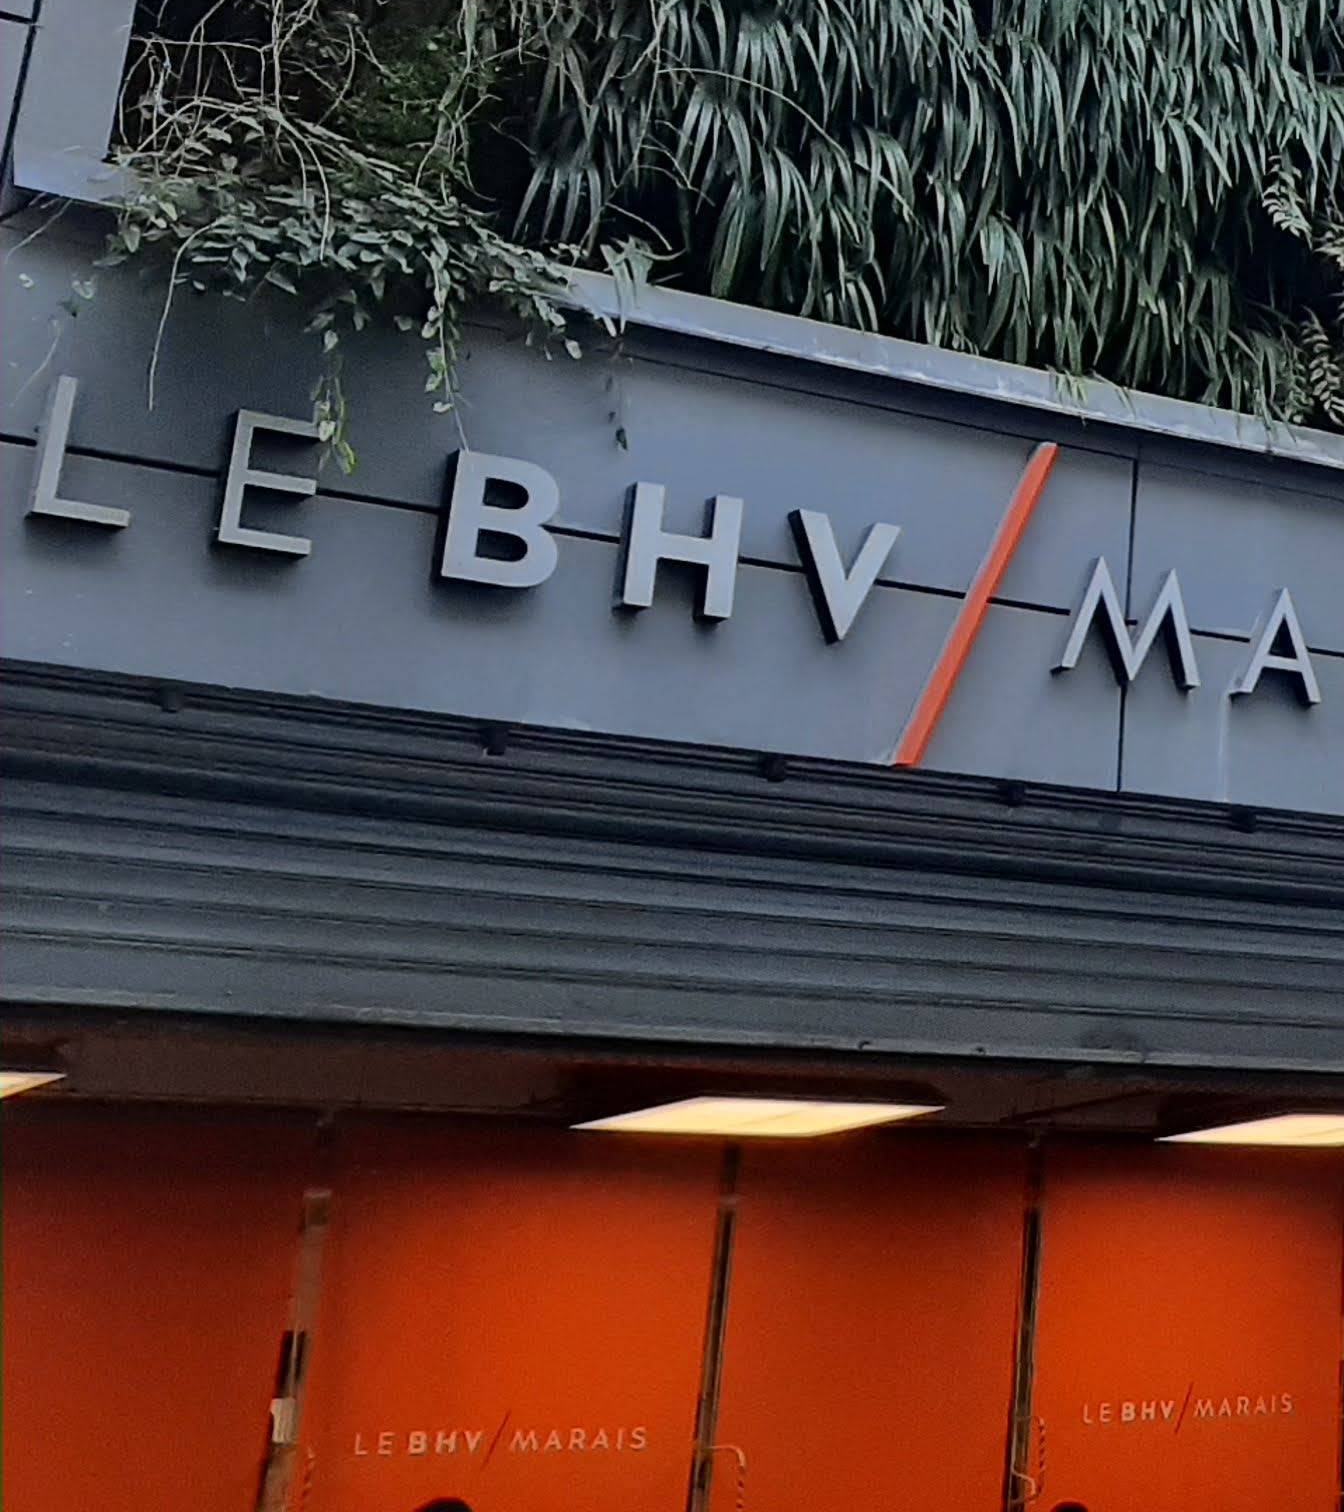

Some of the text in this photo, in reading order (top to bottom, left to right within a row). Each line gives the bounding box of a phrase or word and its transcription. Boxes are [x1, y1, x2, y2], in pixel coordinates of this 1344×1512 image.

[26, 374, 318, 558] LE
[1083, 1402, 1113, 1425] LE
[353, 1431, 396, 1456] LE
